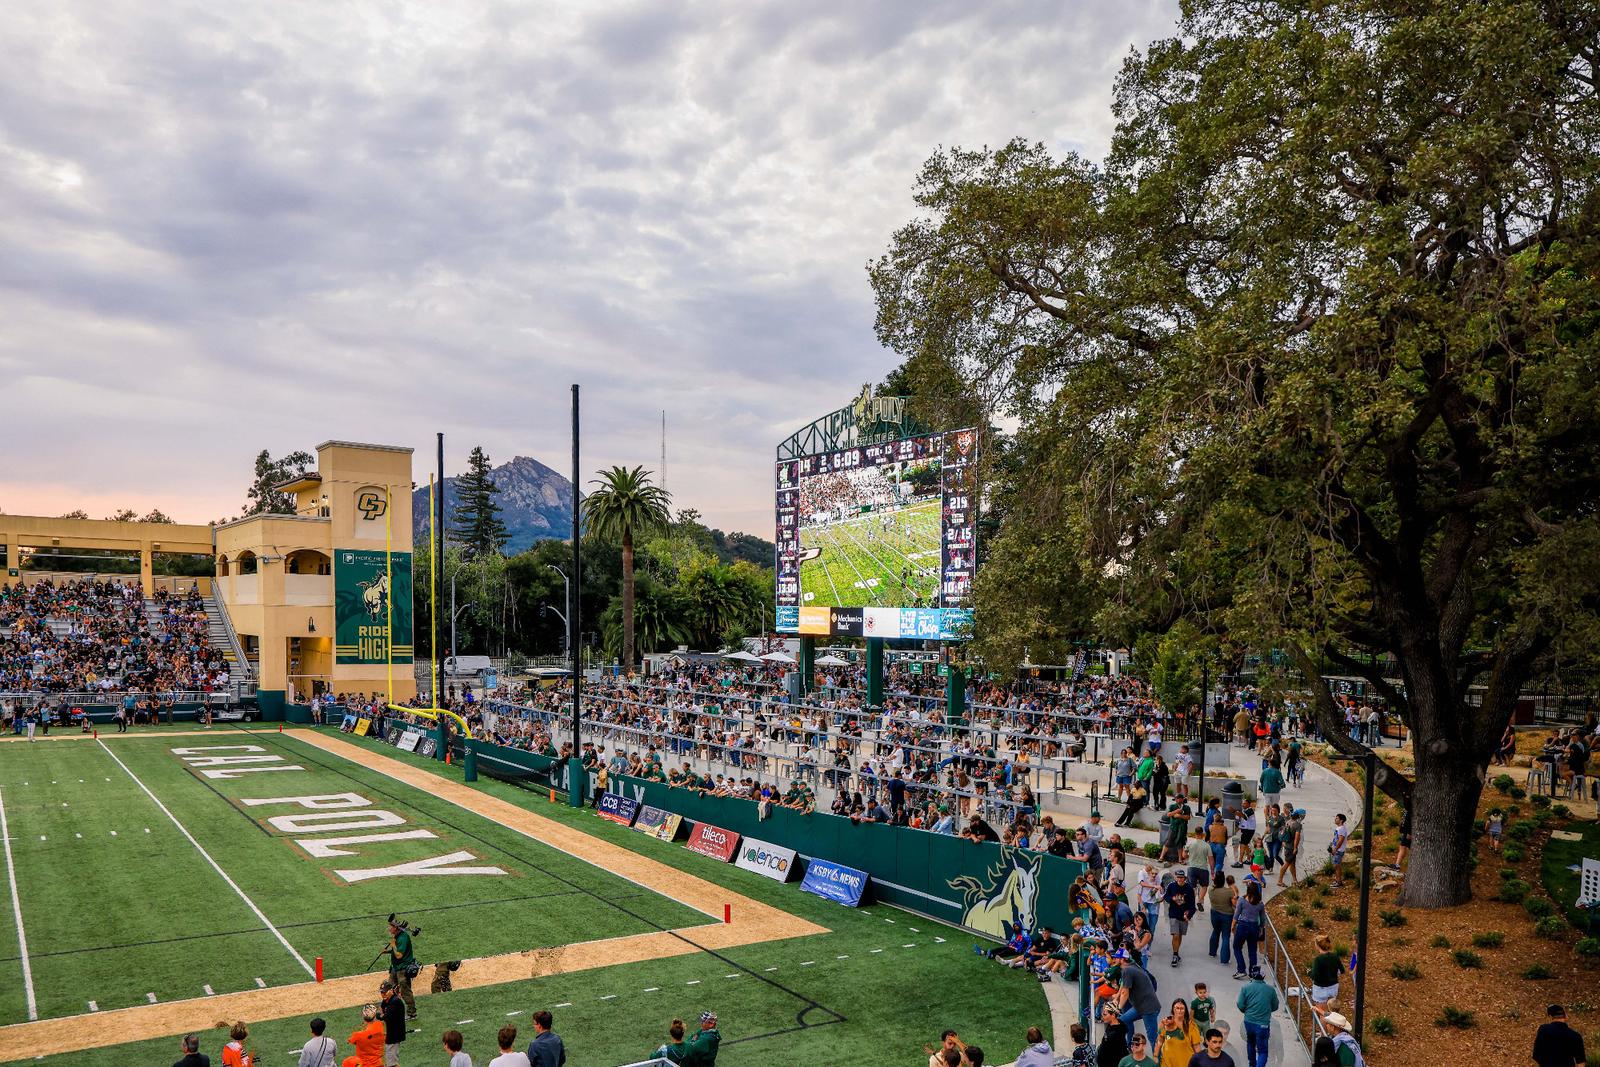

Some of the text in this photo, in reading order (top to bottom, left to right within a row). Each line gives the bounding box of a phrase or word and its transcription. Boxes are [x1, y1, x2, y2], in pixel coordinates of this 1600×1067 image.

[832, 396, 905, 437] CAL POLY
[800, 459, 810, 473] 14
[834, 450, 860, 468] 6:09
[900, 441, 912, 453] 22
[358, 493, 386, 520] CP
[950, 496, 967, 509] 219
[781, 515, 793, 525] 197
[837, 614, 862, 623] Mechanics
[837, 622, 850, 630] Bank
[358, 625, 388, 637] RIDE
[171, 745, 306, 779] CAL
[602, 796, 618, 809] CCB
[240, 792, 509, 883] POLY
[702, 825, 726, 844] tileco
[742, 847, 787, 872] valencia
[812, 864, 832, 879] KSBY
[840, 872, 860, 888] NEWS
